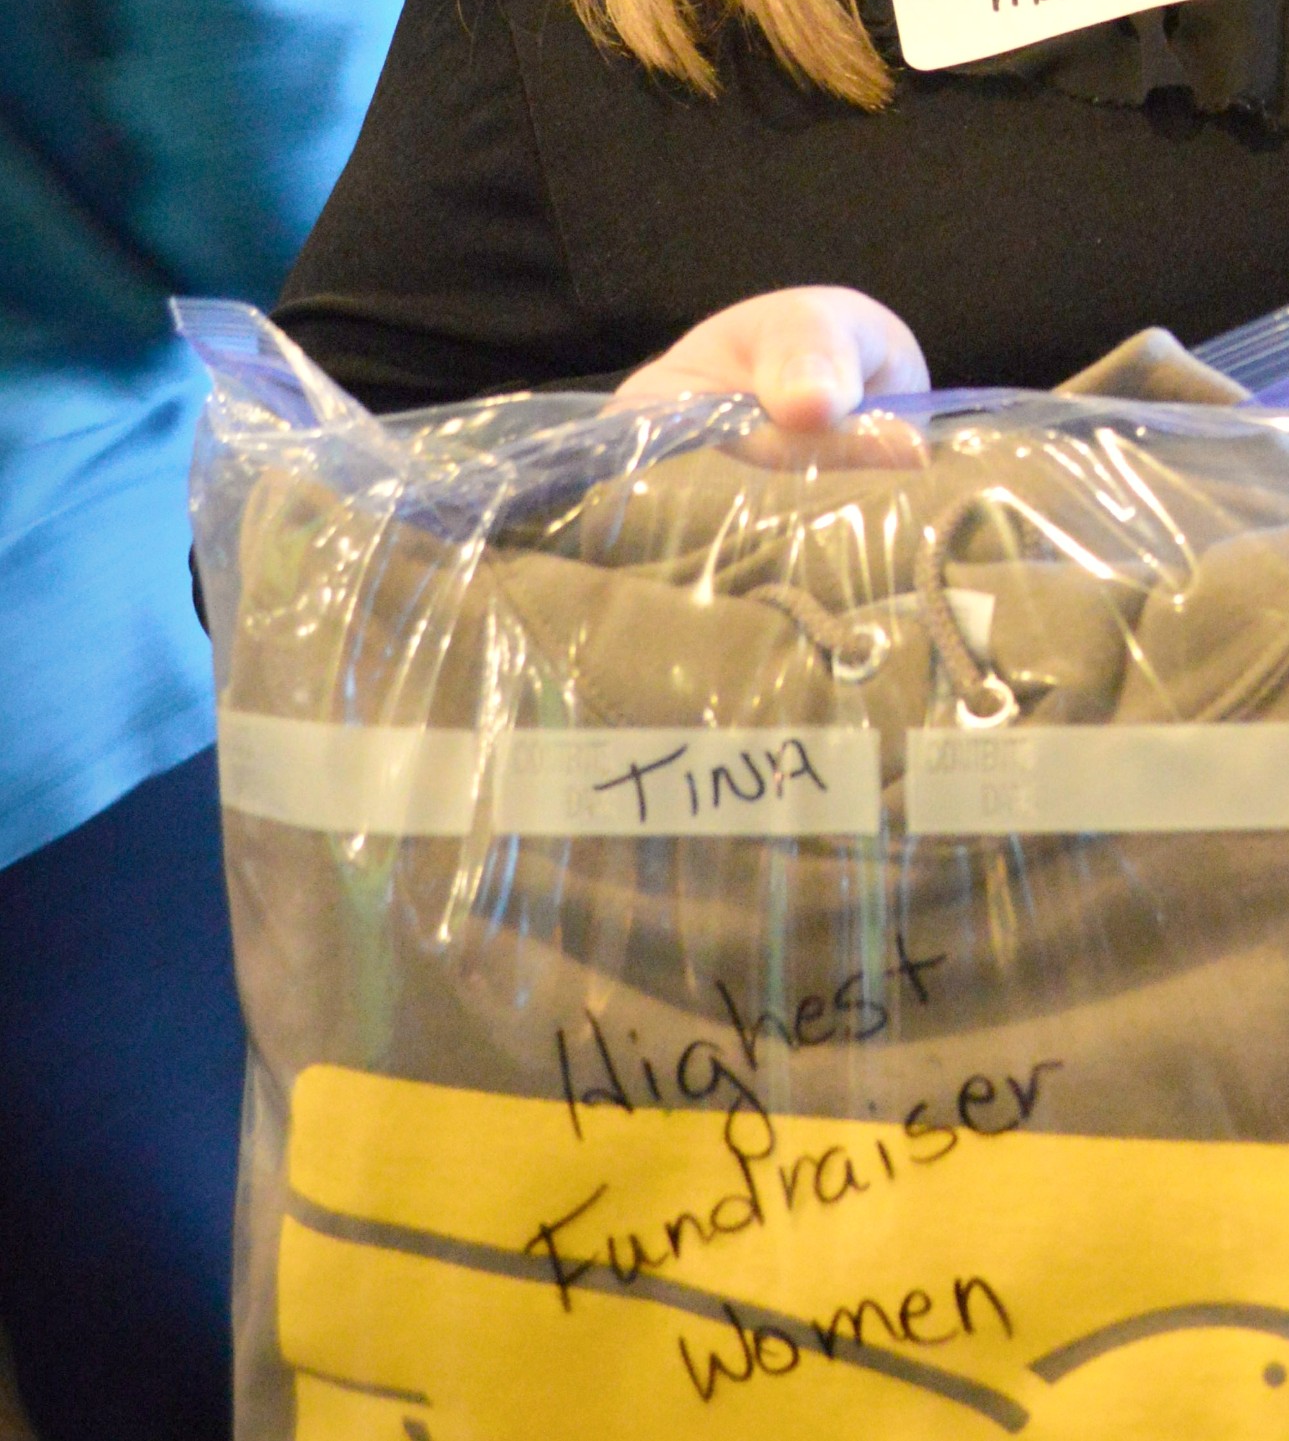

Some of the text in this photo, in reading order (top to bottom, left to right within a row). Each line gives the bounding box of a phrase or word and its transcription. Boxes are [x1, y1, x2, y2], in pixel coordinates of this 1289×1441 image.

[592, 738, 828, 824] TINA
[555, 931, 949, 1160] Highest
[523, 1060, 1064, 1313] Fundraiser
